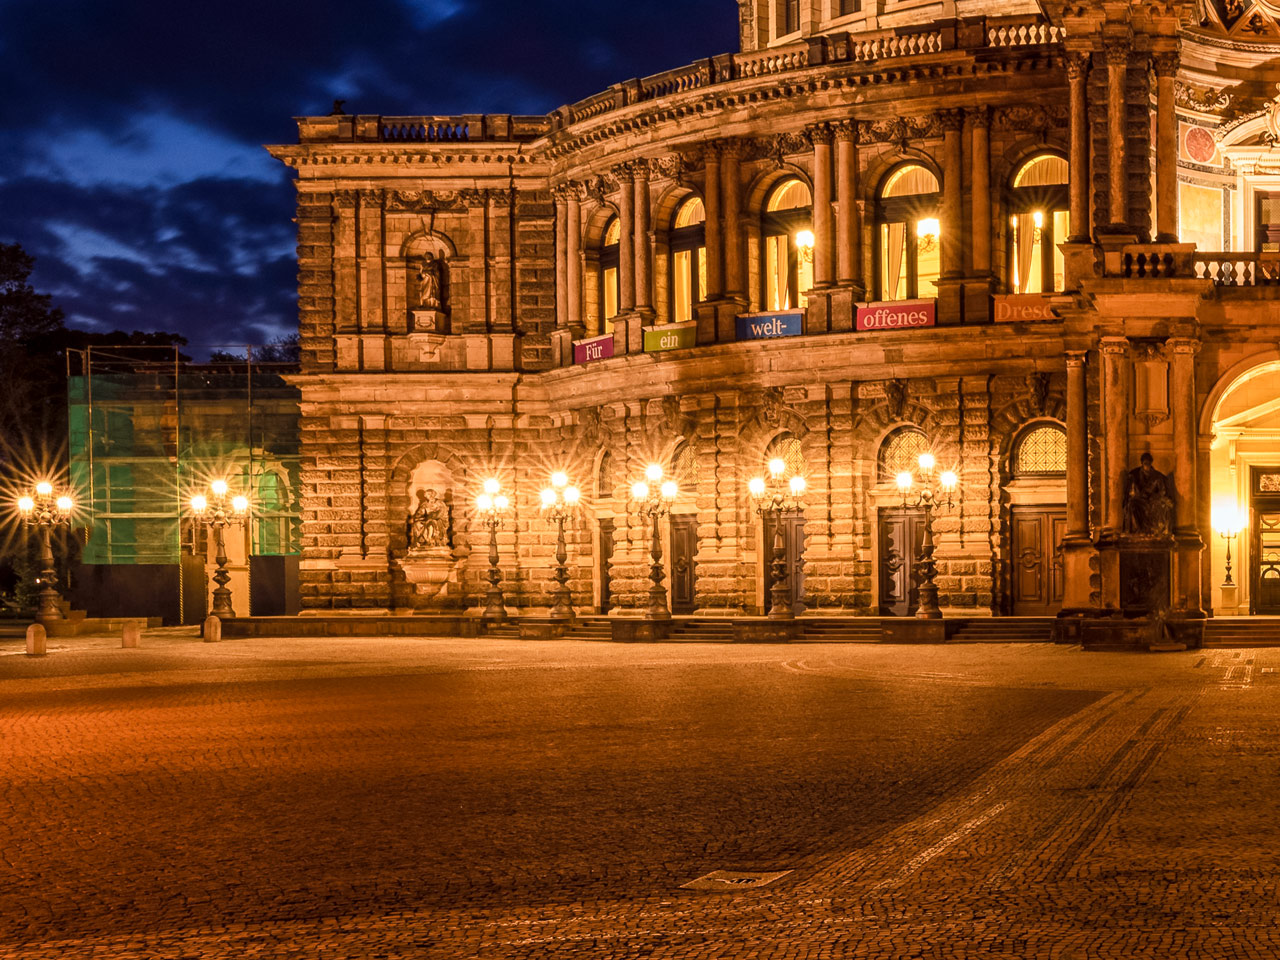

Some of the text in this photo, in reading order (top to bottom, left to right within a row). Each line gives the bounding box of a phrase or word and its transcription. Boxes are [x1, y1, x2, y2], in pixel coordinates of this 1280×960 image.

[751, 317, 788, 336] welt-
[863, 309, 928, 328] offenes
[660, 331, 679, 348] ein
[585, 342, 603, 360] Für
